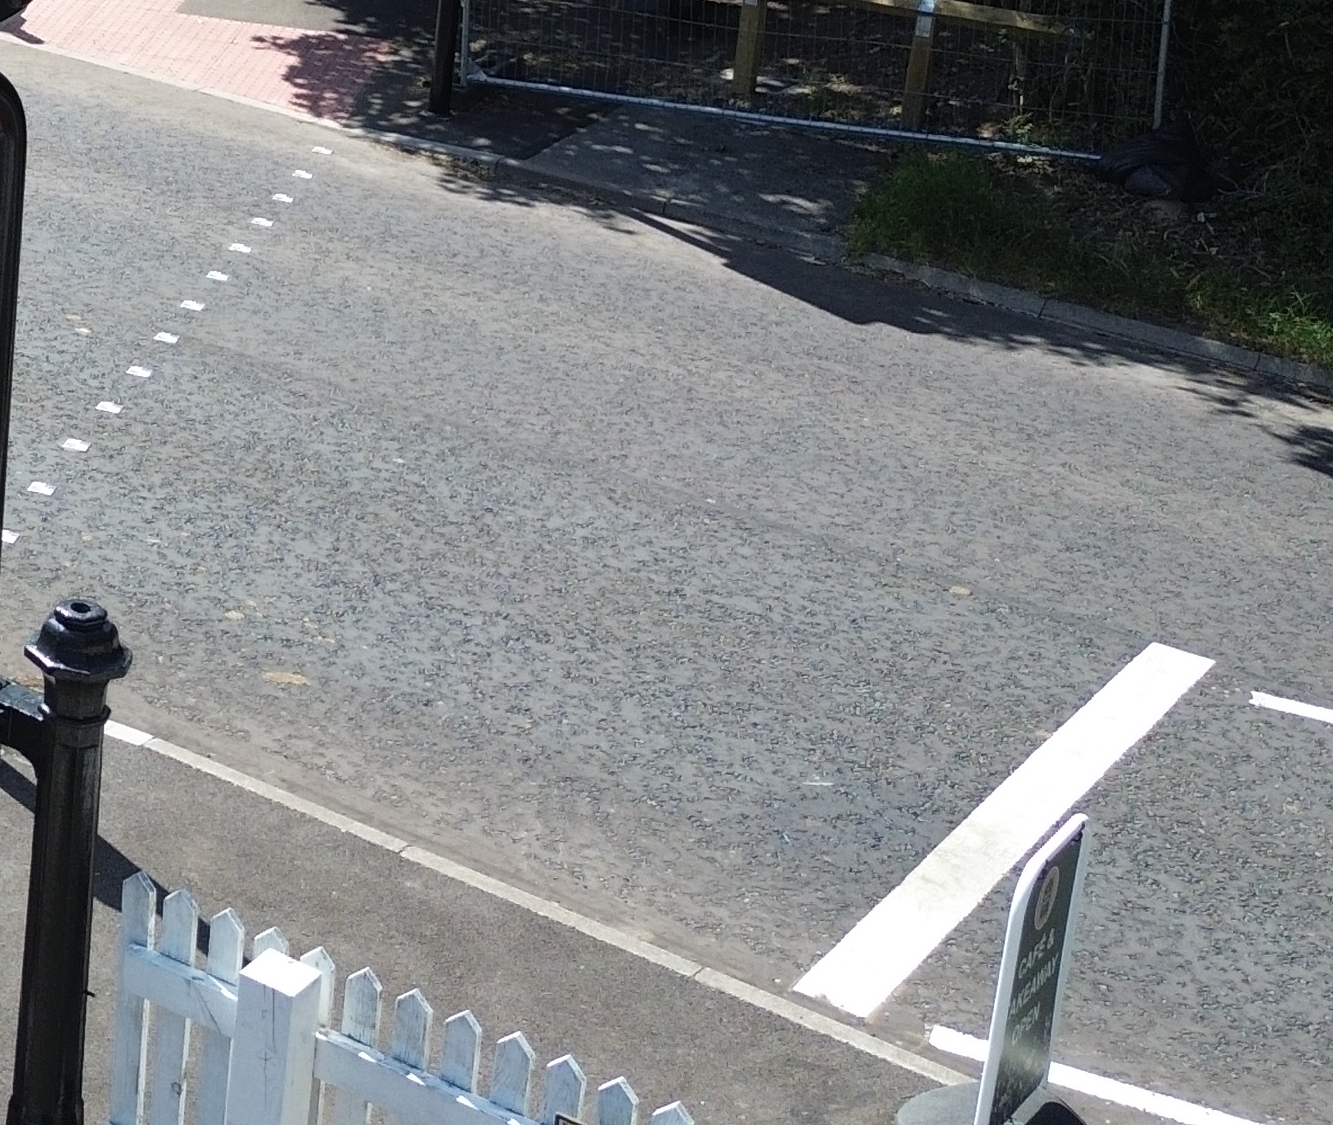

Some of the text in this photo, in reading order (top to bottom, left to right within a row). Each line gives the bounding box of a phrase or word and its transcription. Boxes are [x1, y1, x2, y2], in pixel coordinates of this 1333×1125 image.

[1018, 928, 1055, 979] CAFÉ &
[1008, 953, 1059, 1020] AKEAWAY
[1012, 1001, 1041, 1046] OPEN
